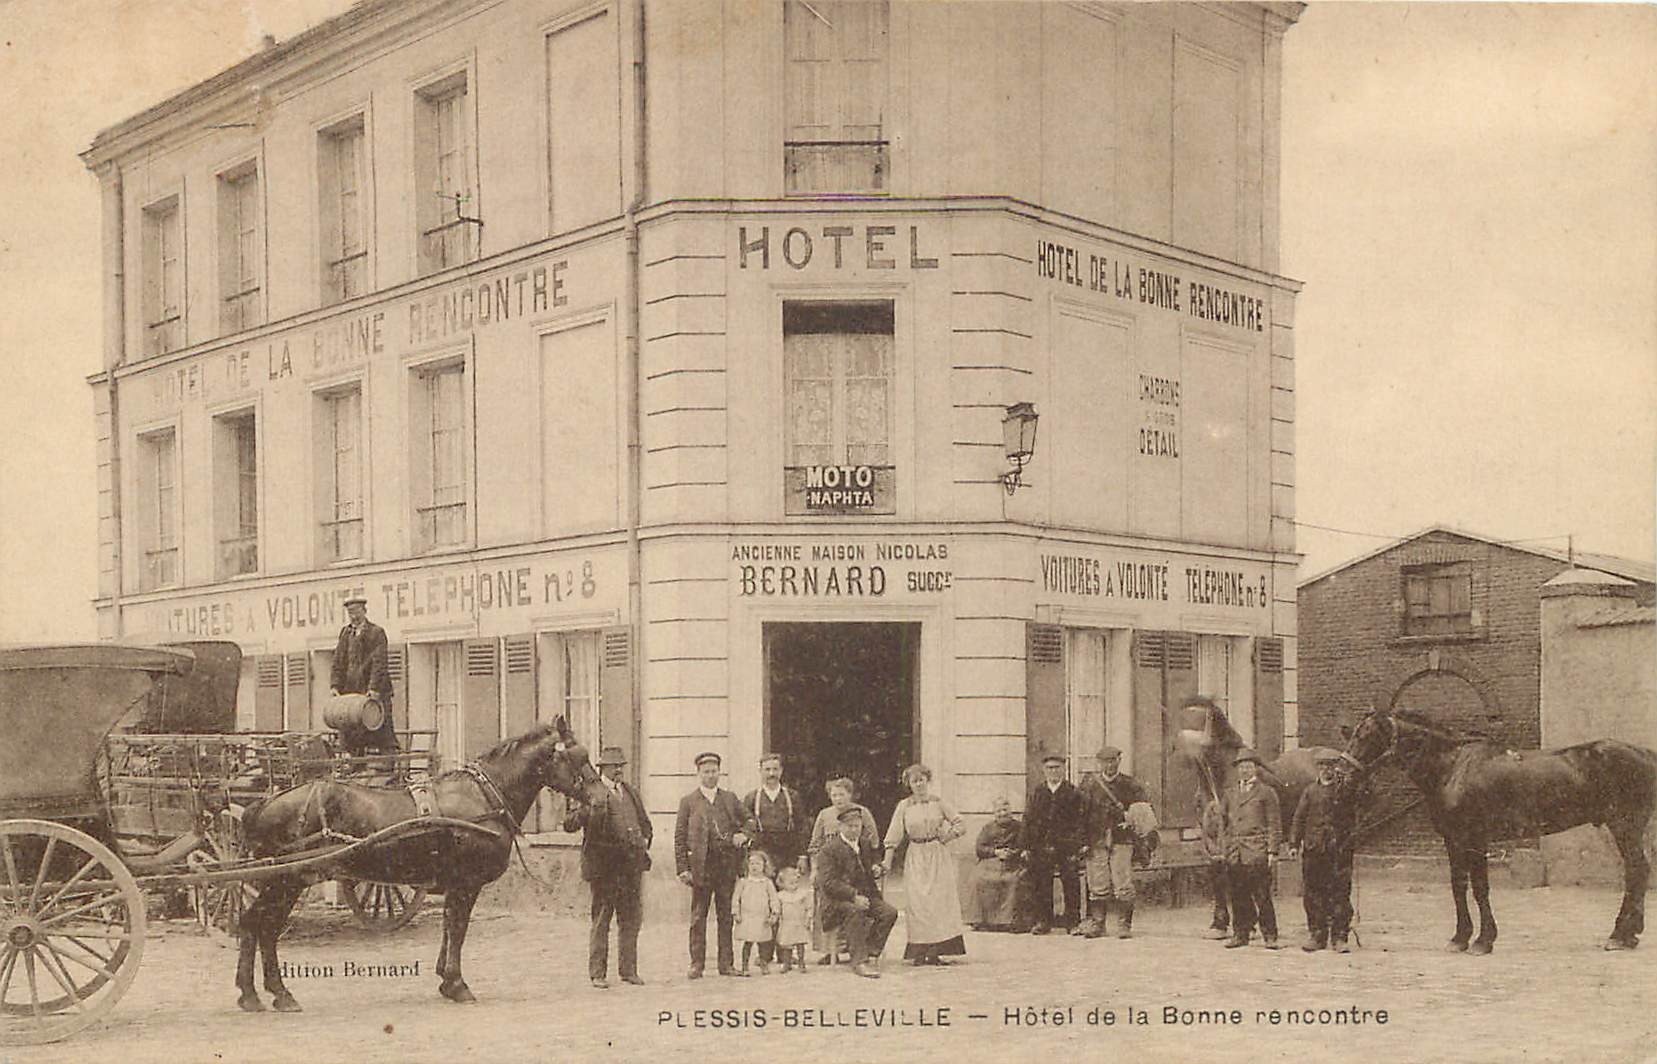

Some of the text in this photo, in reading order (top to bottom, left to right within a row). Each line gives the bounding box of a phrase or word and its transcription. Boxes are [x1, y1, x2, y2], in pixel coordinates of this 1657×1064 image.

[739, 226, 939, 269] HOTEL
[1038, 240, 1264, 332] HOTEL DE LA BONNE RENCONTRE
[268, 340, 293, 381] LA
[408, 260, 569, 345] RENCONTRE
[806, 466, 872, 488] MOTO
[732, 543, 948, 561] ANCIENNE MAISON NICOLAS
[582, 560, 596, 600] 8
[740, 566, 887, 596] BERNARD
[1041, 554, 1100, 597] VOITURES
[1117, 560, 1169, 601] VOLONTÉ
[1185, 564, 1244, 607] TÉLÉPHONE
[1259, 575, 1267, 608] 8
